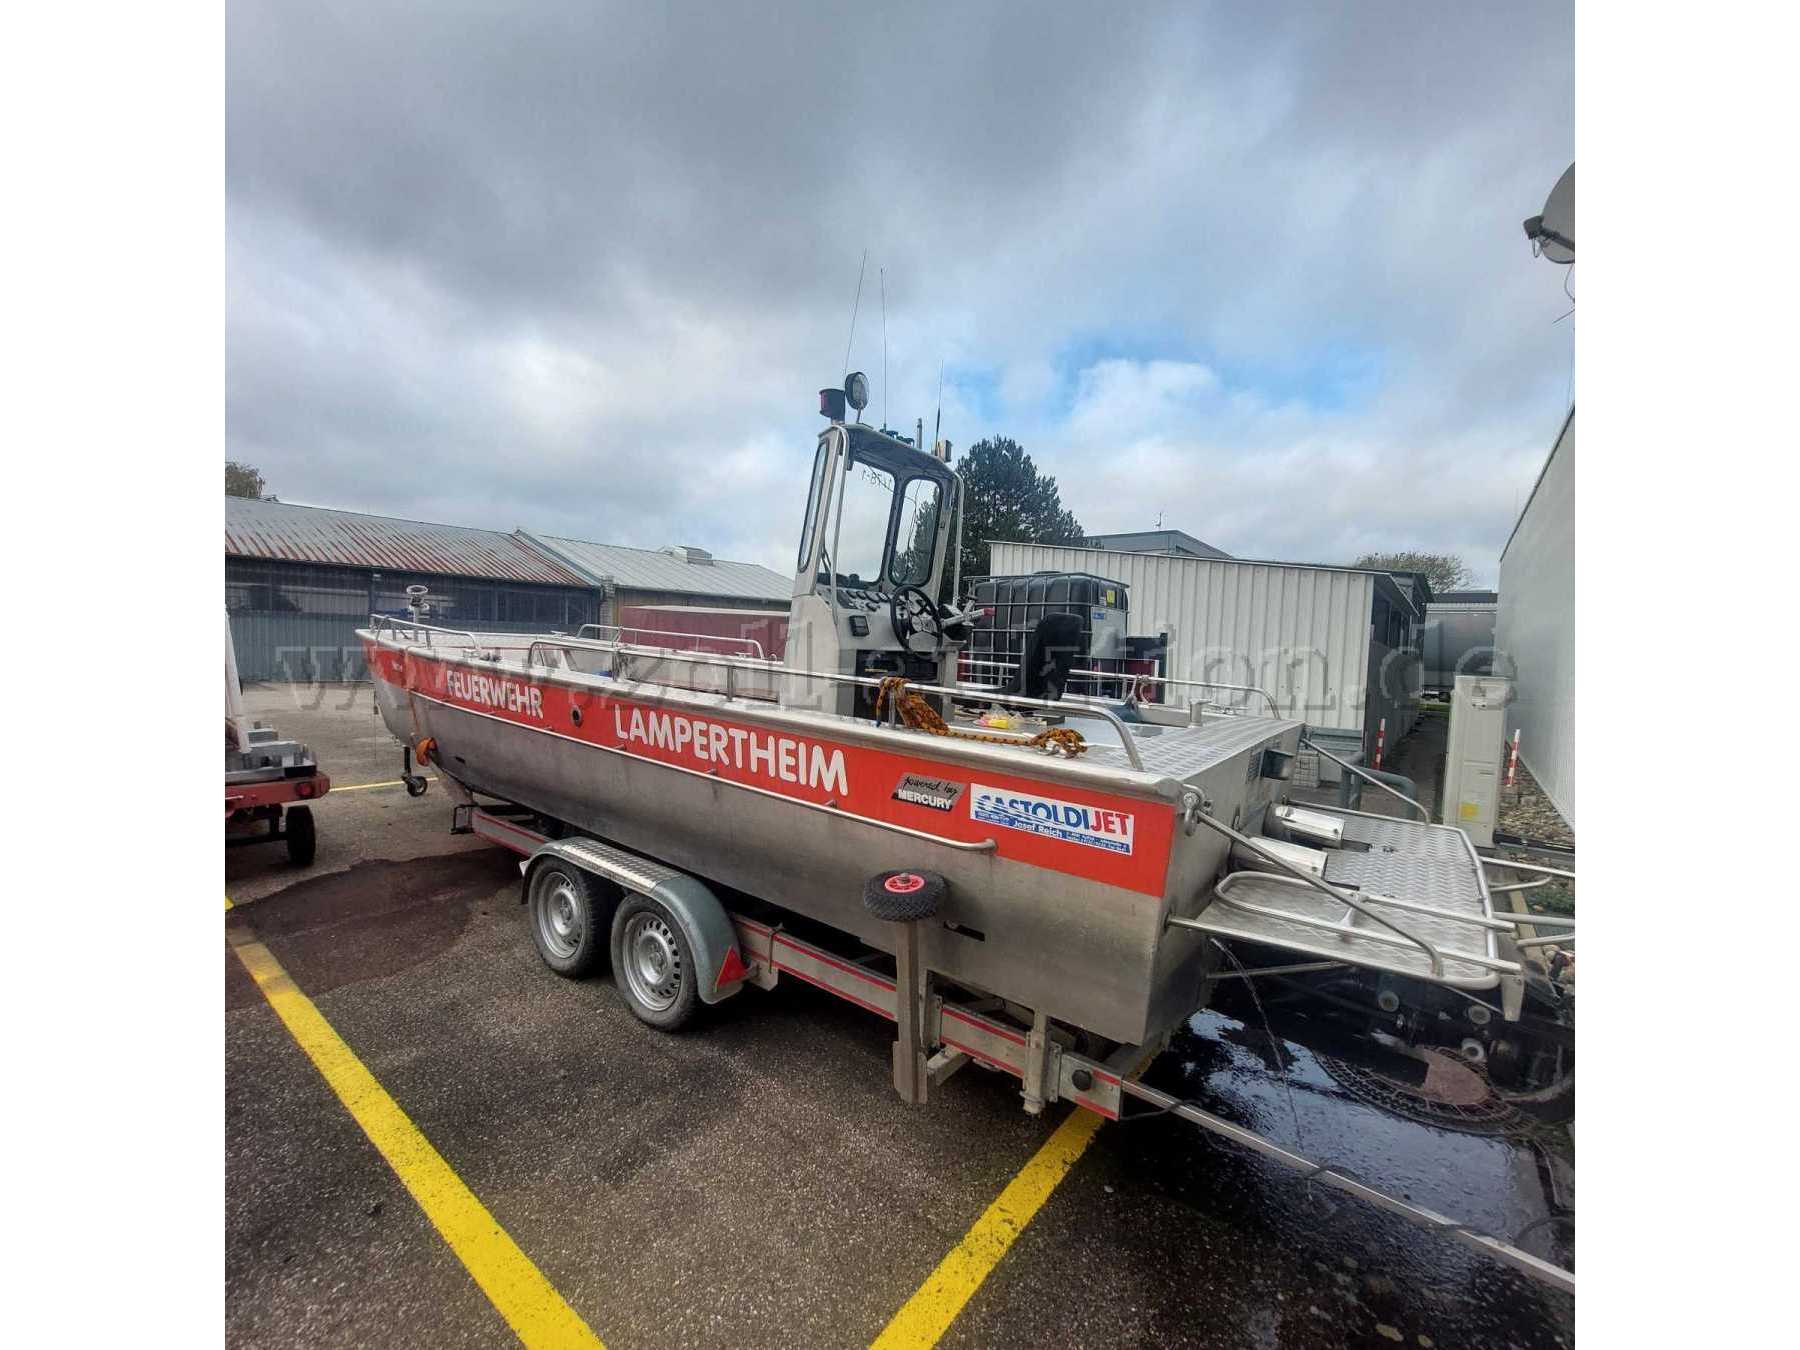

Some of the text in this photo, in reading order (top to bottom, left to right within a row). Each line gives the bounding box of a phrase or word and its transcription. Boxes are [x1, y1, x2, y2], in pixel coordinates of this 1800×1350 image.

[446, 669, 544, 720] FEUERWEHR
[614, 703, 849, 796] LAMPERTHEIM
[897, 788, 952, 809] MERCURY
[1013, 820, 1063, 838] Josef Reich
